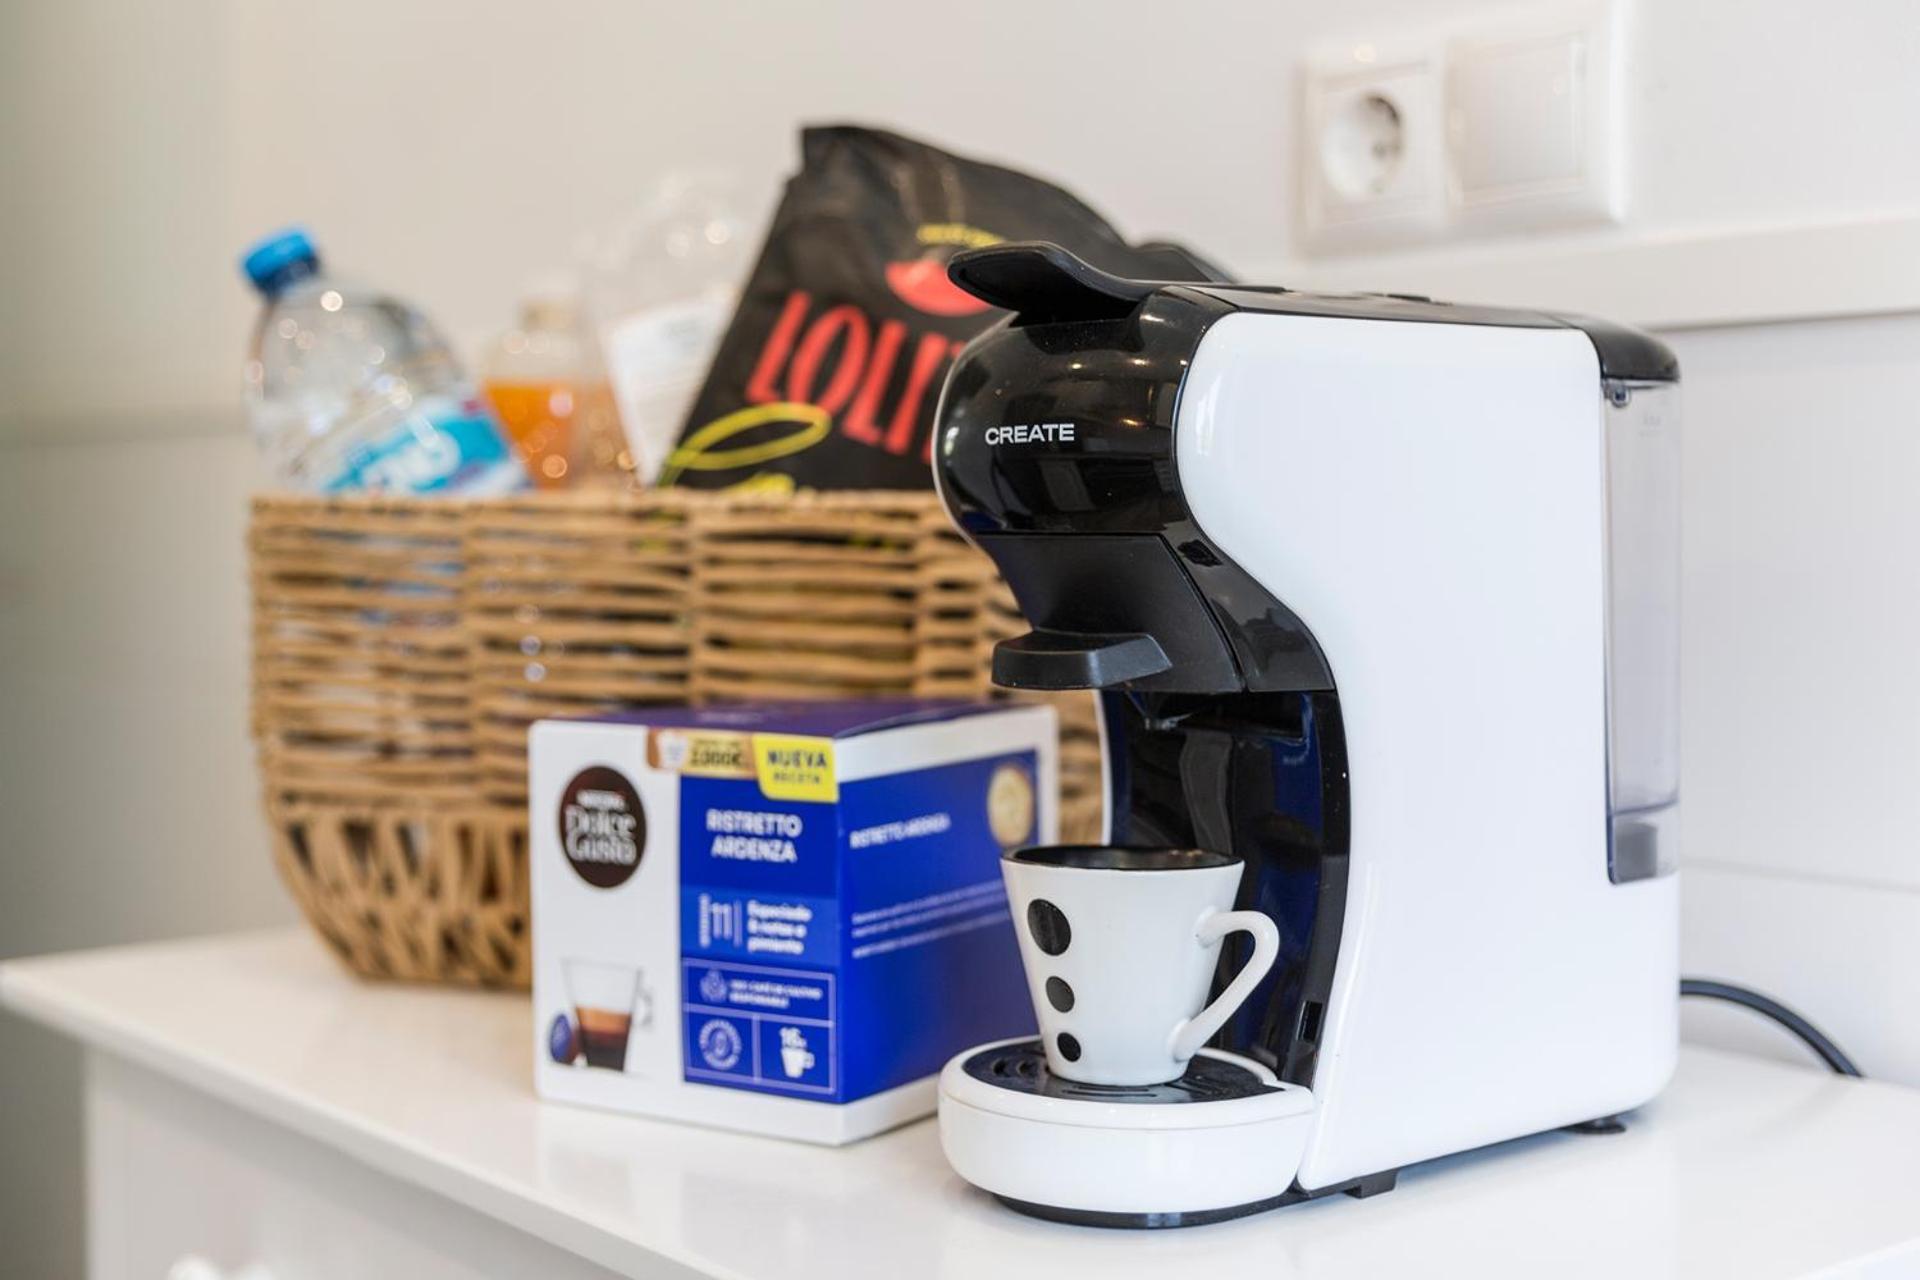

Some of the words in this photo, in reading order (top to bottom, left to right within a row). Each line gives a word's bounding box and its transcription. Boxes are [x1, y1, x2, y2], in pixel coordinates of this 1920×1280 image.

[744, 291, 966, 464] LOLI
[985, 423, 1075, 445] CREATE
[767, 750, 828, 769] NUEVA
[706, 808, 803, 837] RISTRETTO
[711, 835, 798, 863] ARDENZA
